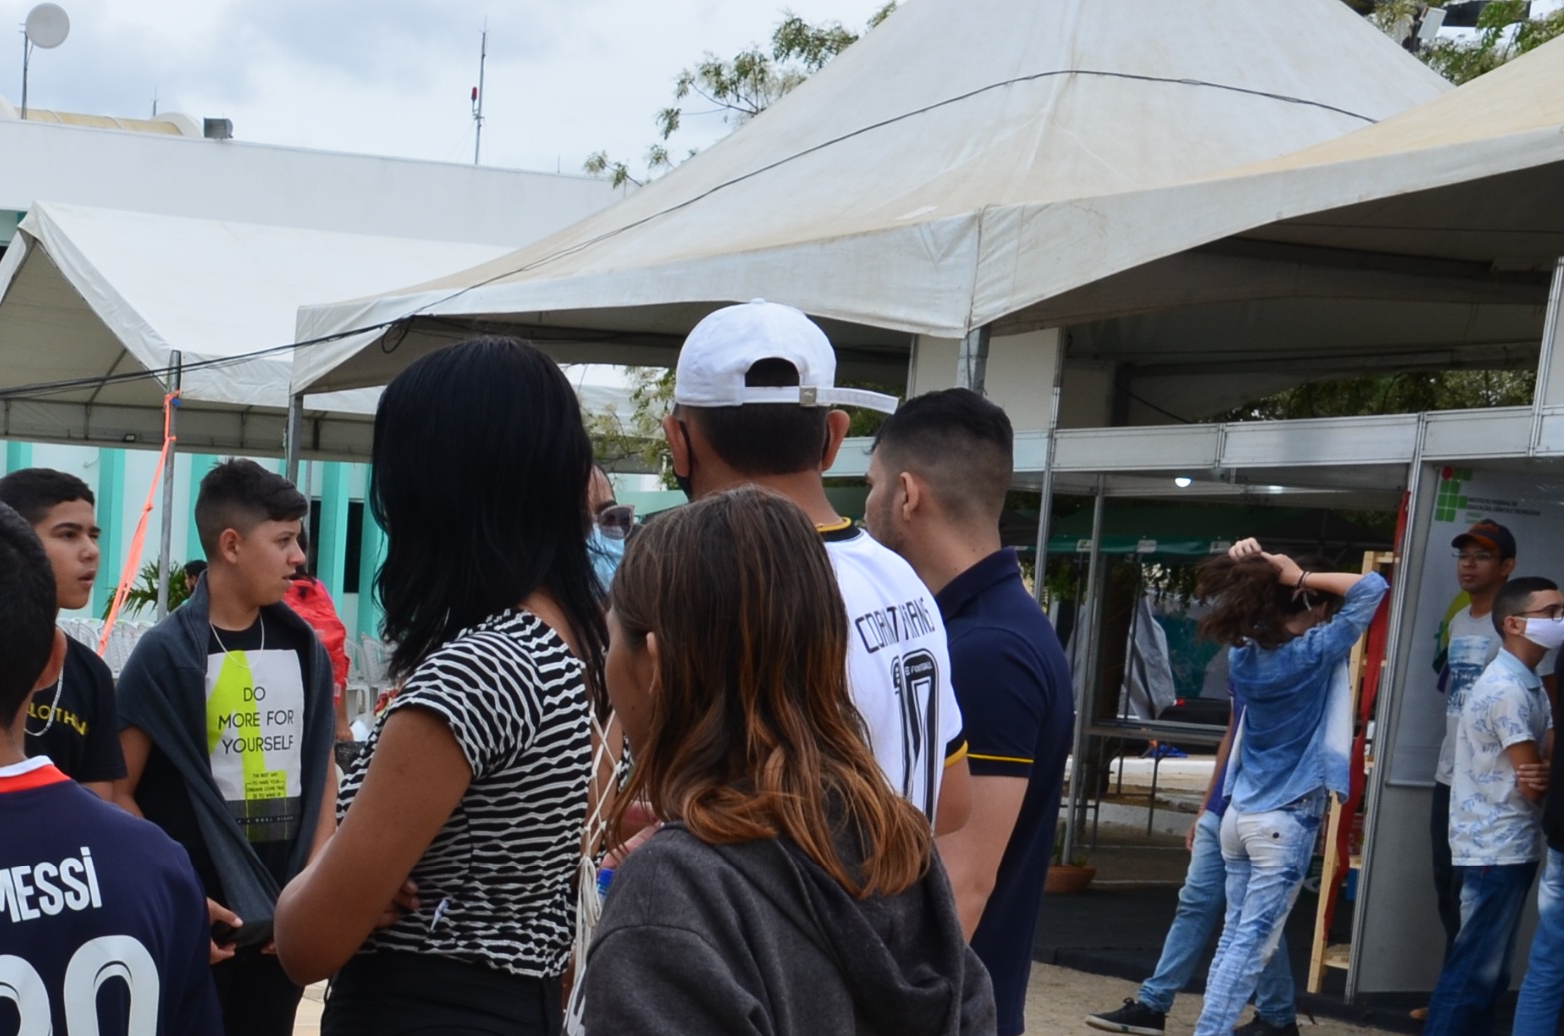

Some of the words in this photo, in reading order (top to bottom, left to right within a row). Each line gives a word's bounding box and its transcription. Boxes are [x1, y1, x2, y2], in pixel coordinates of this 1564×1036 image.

[243, 686, 266, 702] DO
[218, 712, 260, 731] MORE
[266, 709, 294, 726] FOR
[222, 735, 294, 755] YOURSELF
